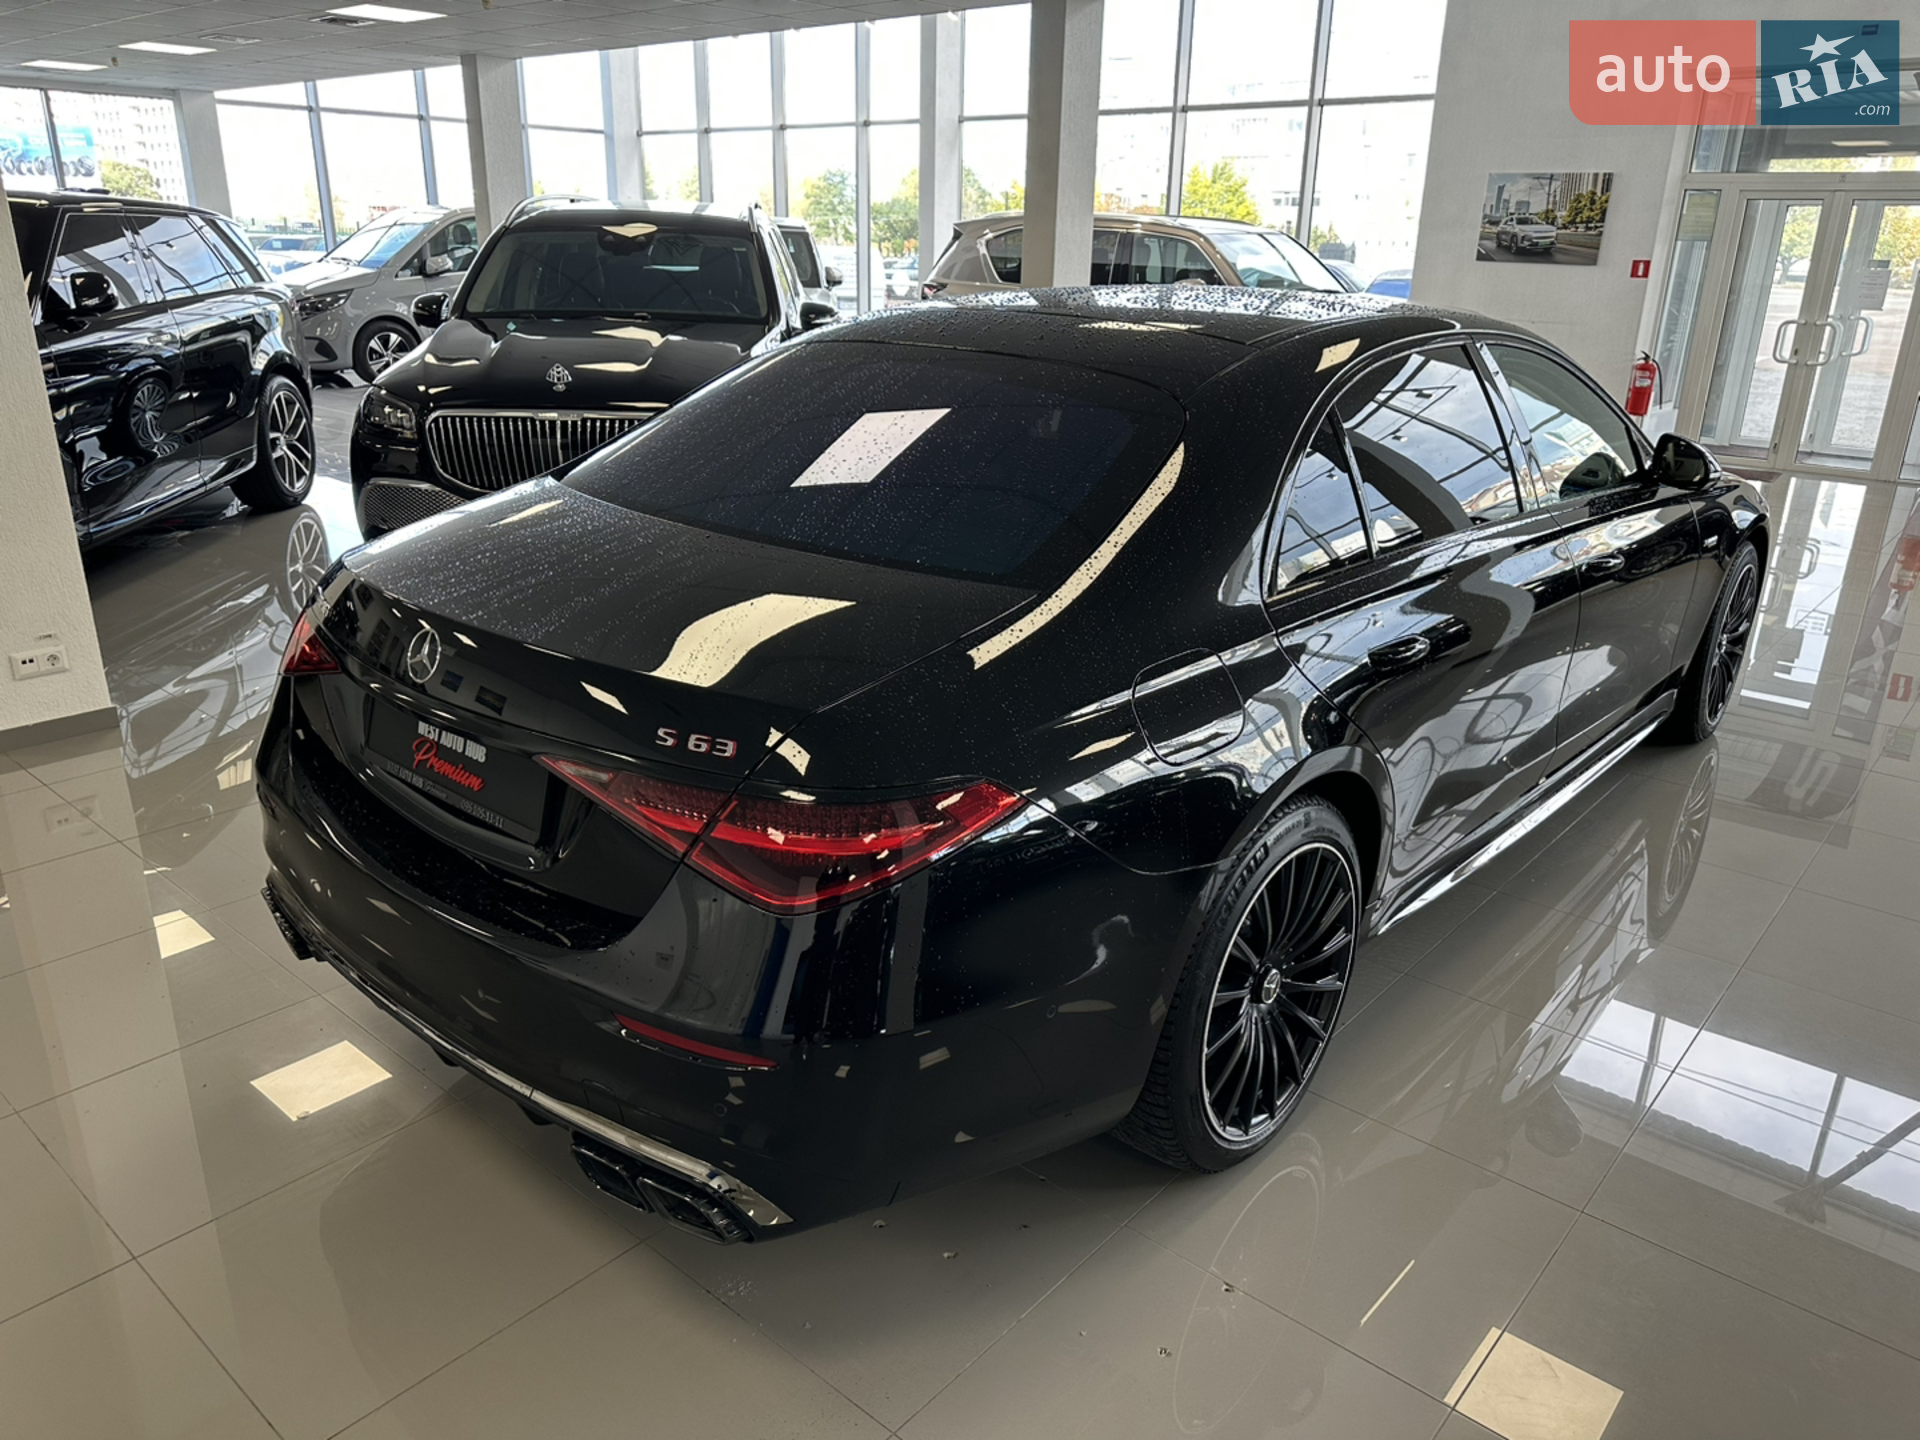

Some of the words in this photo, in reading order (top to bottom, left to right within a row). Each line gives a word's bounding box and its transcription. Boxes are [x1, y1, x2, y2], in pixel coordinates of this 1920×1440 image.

[417, 720, 440, 742] WEST
[439, 730, 465, 753] AUTO
[464, 739, 487, 763] HUB
[655, 727, 678, 747] S
[687, 733, 738, 759] 63
[412, 736, 485, 792] Premium
